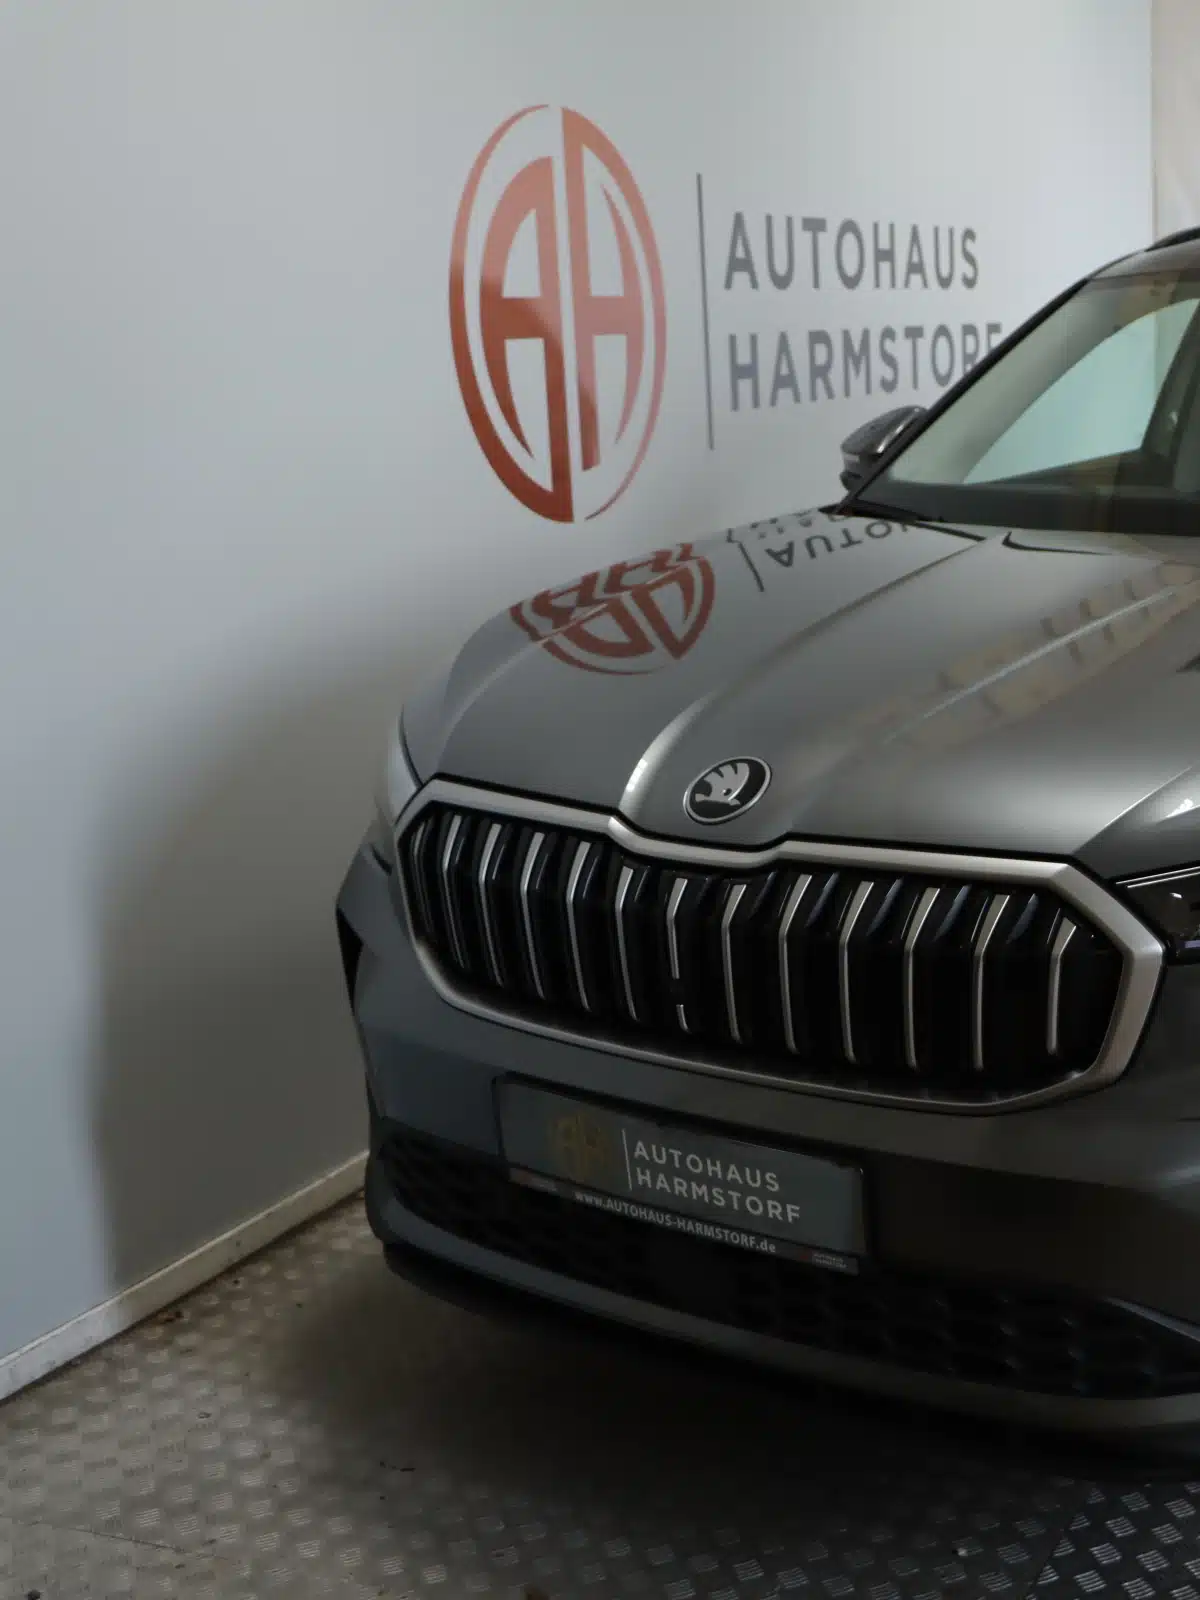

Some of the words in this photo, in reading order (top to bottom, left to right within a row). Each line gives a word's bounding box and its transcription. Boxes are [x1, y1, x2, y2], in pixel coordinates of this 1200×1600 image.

[723, 211, 979, 291] AUTOHAUS
[633, 1139, 780, 1192] AUTOHAUS
[635, 1166, 801, 1224] HARMSTORF
[574, 1191, 777, 1253] www.AUTOHAUS-HARMSTORF.de
